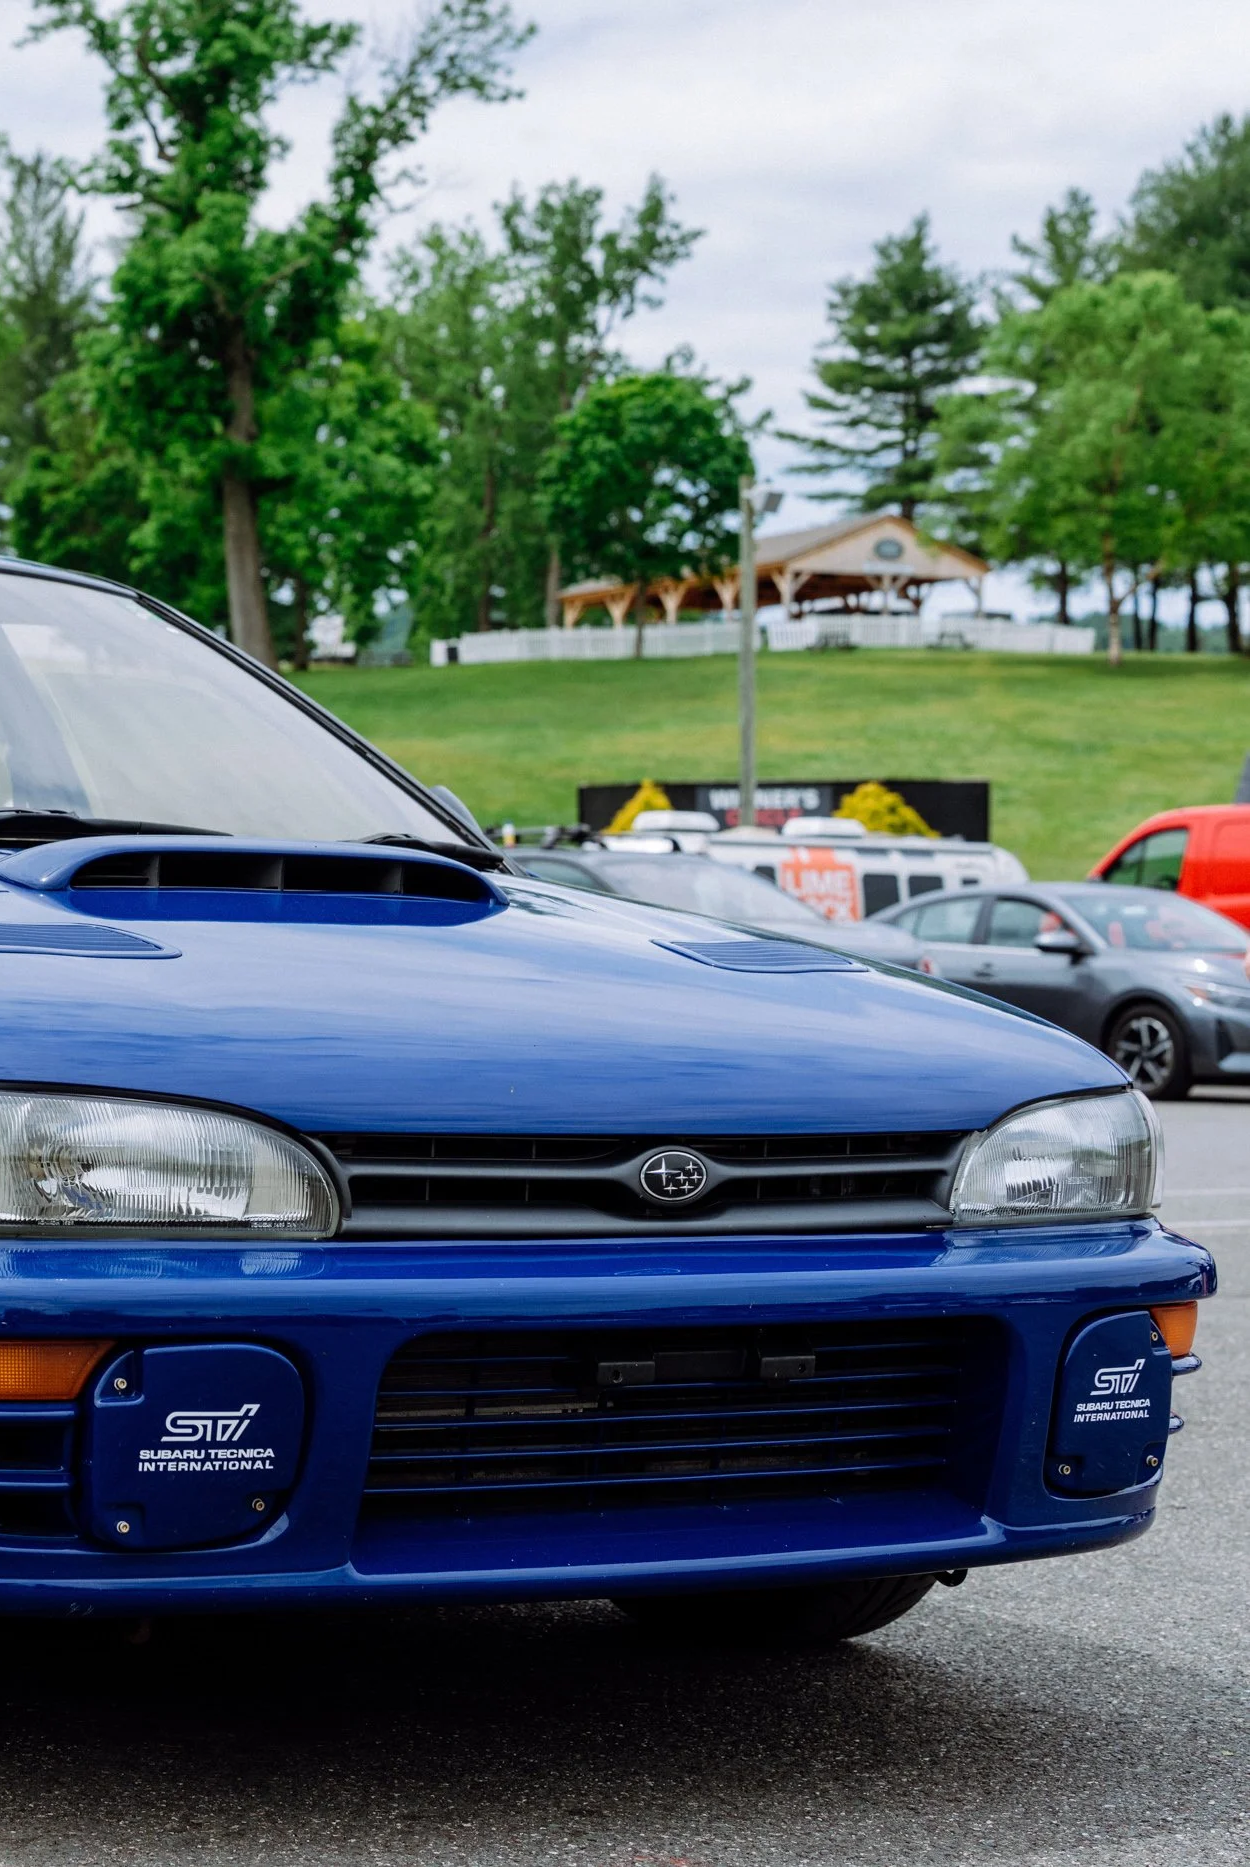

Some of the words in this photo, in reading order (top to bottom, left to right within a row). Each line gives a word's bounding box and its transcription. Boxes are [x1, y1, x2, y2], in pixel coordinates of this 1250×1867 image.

[709, 788, 820, 810] WINER'S
[1076, 1402, 1114, 1412] SUBARU
[1115, 1399, 1151, 1409] TECNICA
[1073, 1410, 1150, 1423] INTERNATIONAL
[139, 1449, 205, 1460] SUBARU
[208, 1448, 275, 1459] TECNICA
[138, 1460, 274, 1472] INTERNATIONAL
